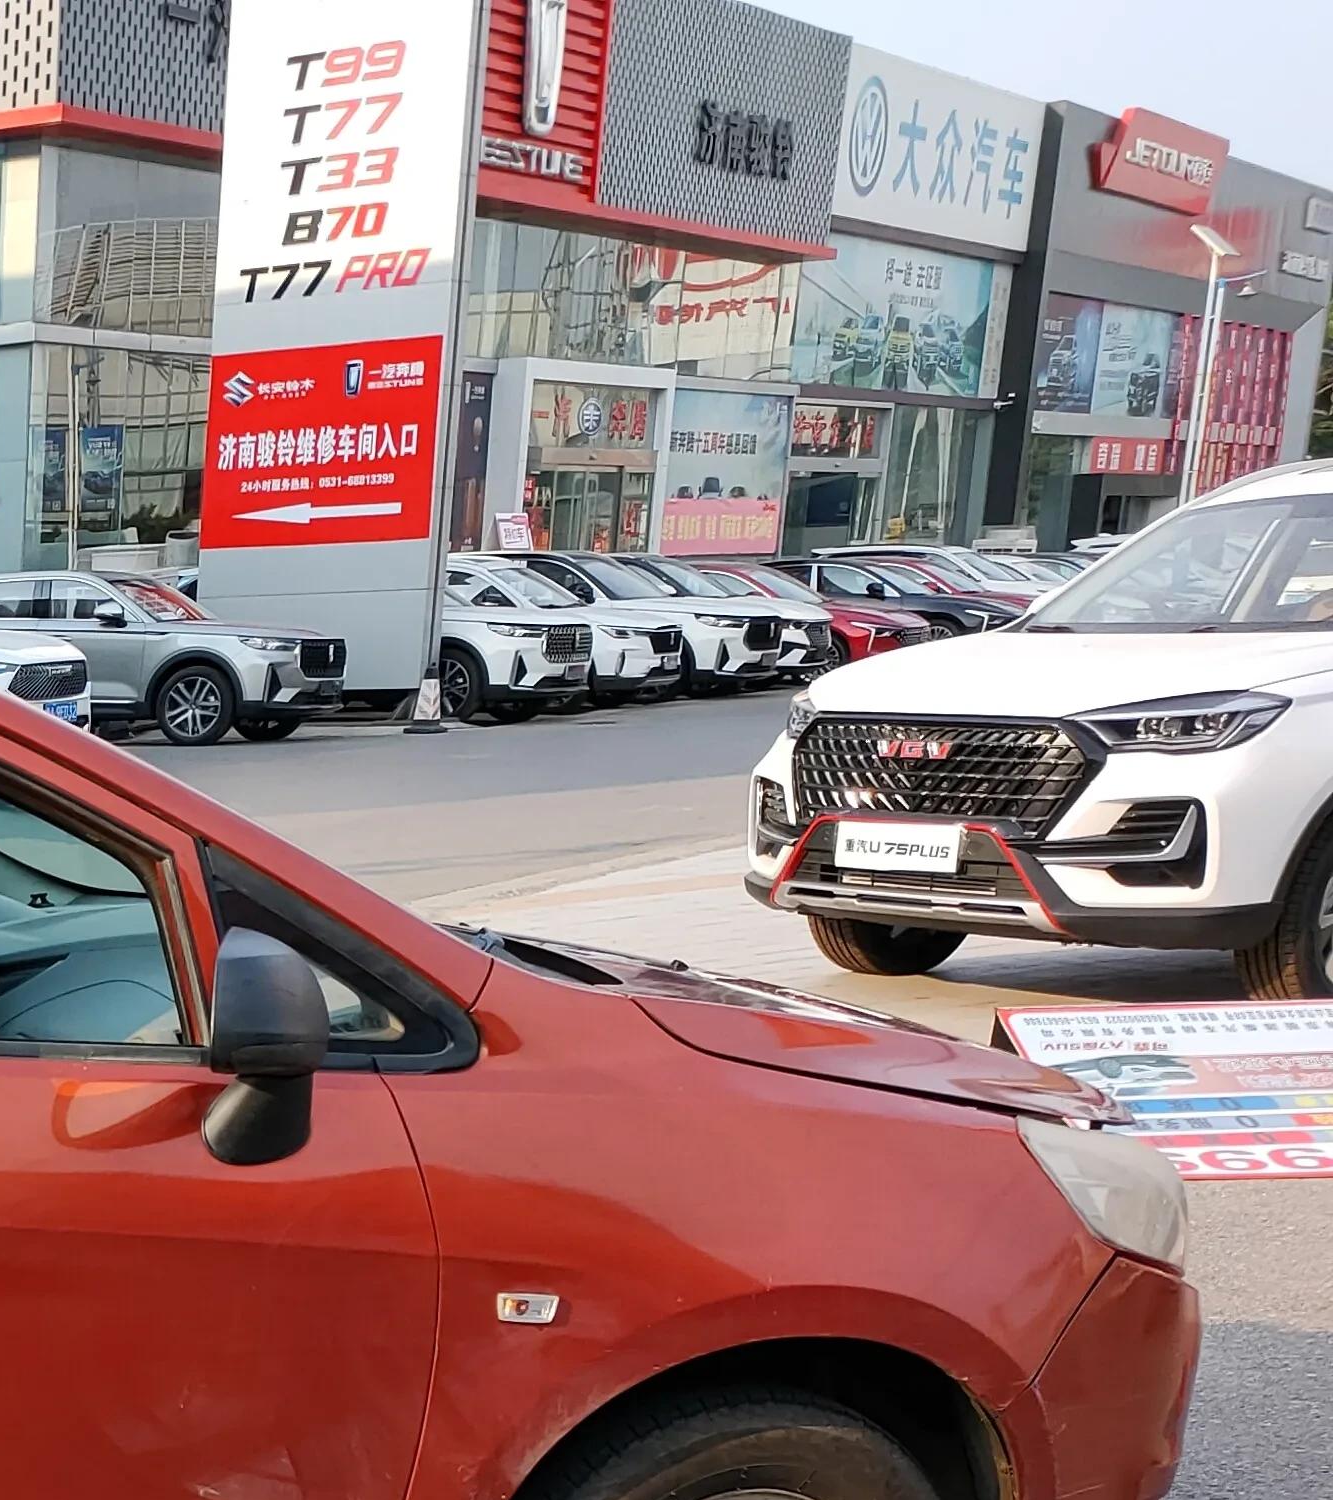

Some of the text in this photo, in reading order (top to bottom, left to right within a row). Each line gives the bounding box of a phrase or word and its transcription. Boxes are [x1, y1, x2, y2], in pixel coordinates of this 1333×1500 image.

[287, 40, 406, 91] T99
[283, 92, 403, 146] T77
[281, 147, 399, 196] T33
[893, 99, 1029, 219] 大众汽车
[282, 202, 389, 246] B70
[240, 248, 432, 303] T77 PRO
[217, 422, 419, 471] 济南骏铃维修车间入口
[877, 739, 954, 760] VGV
